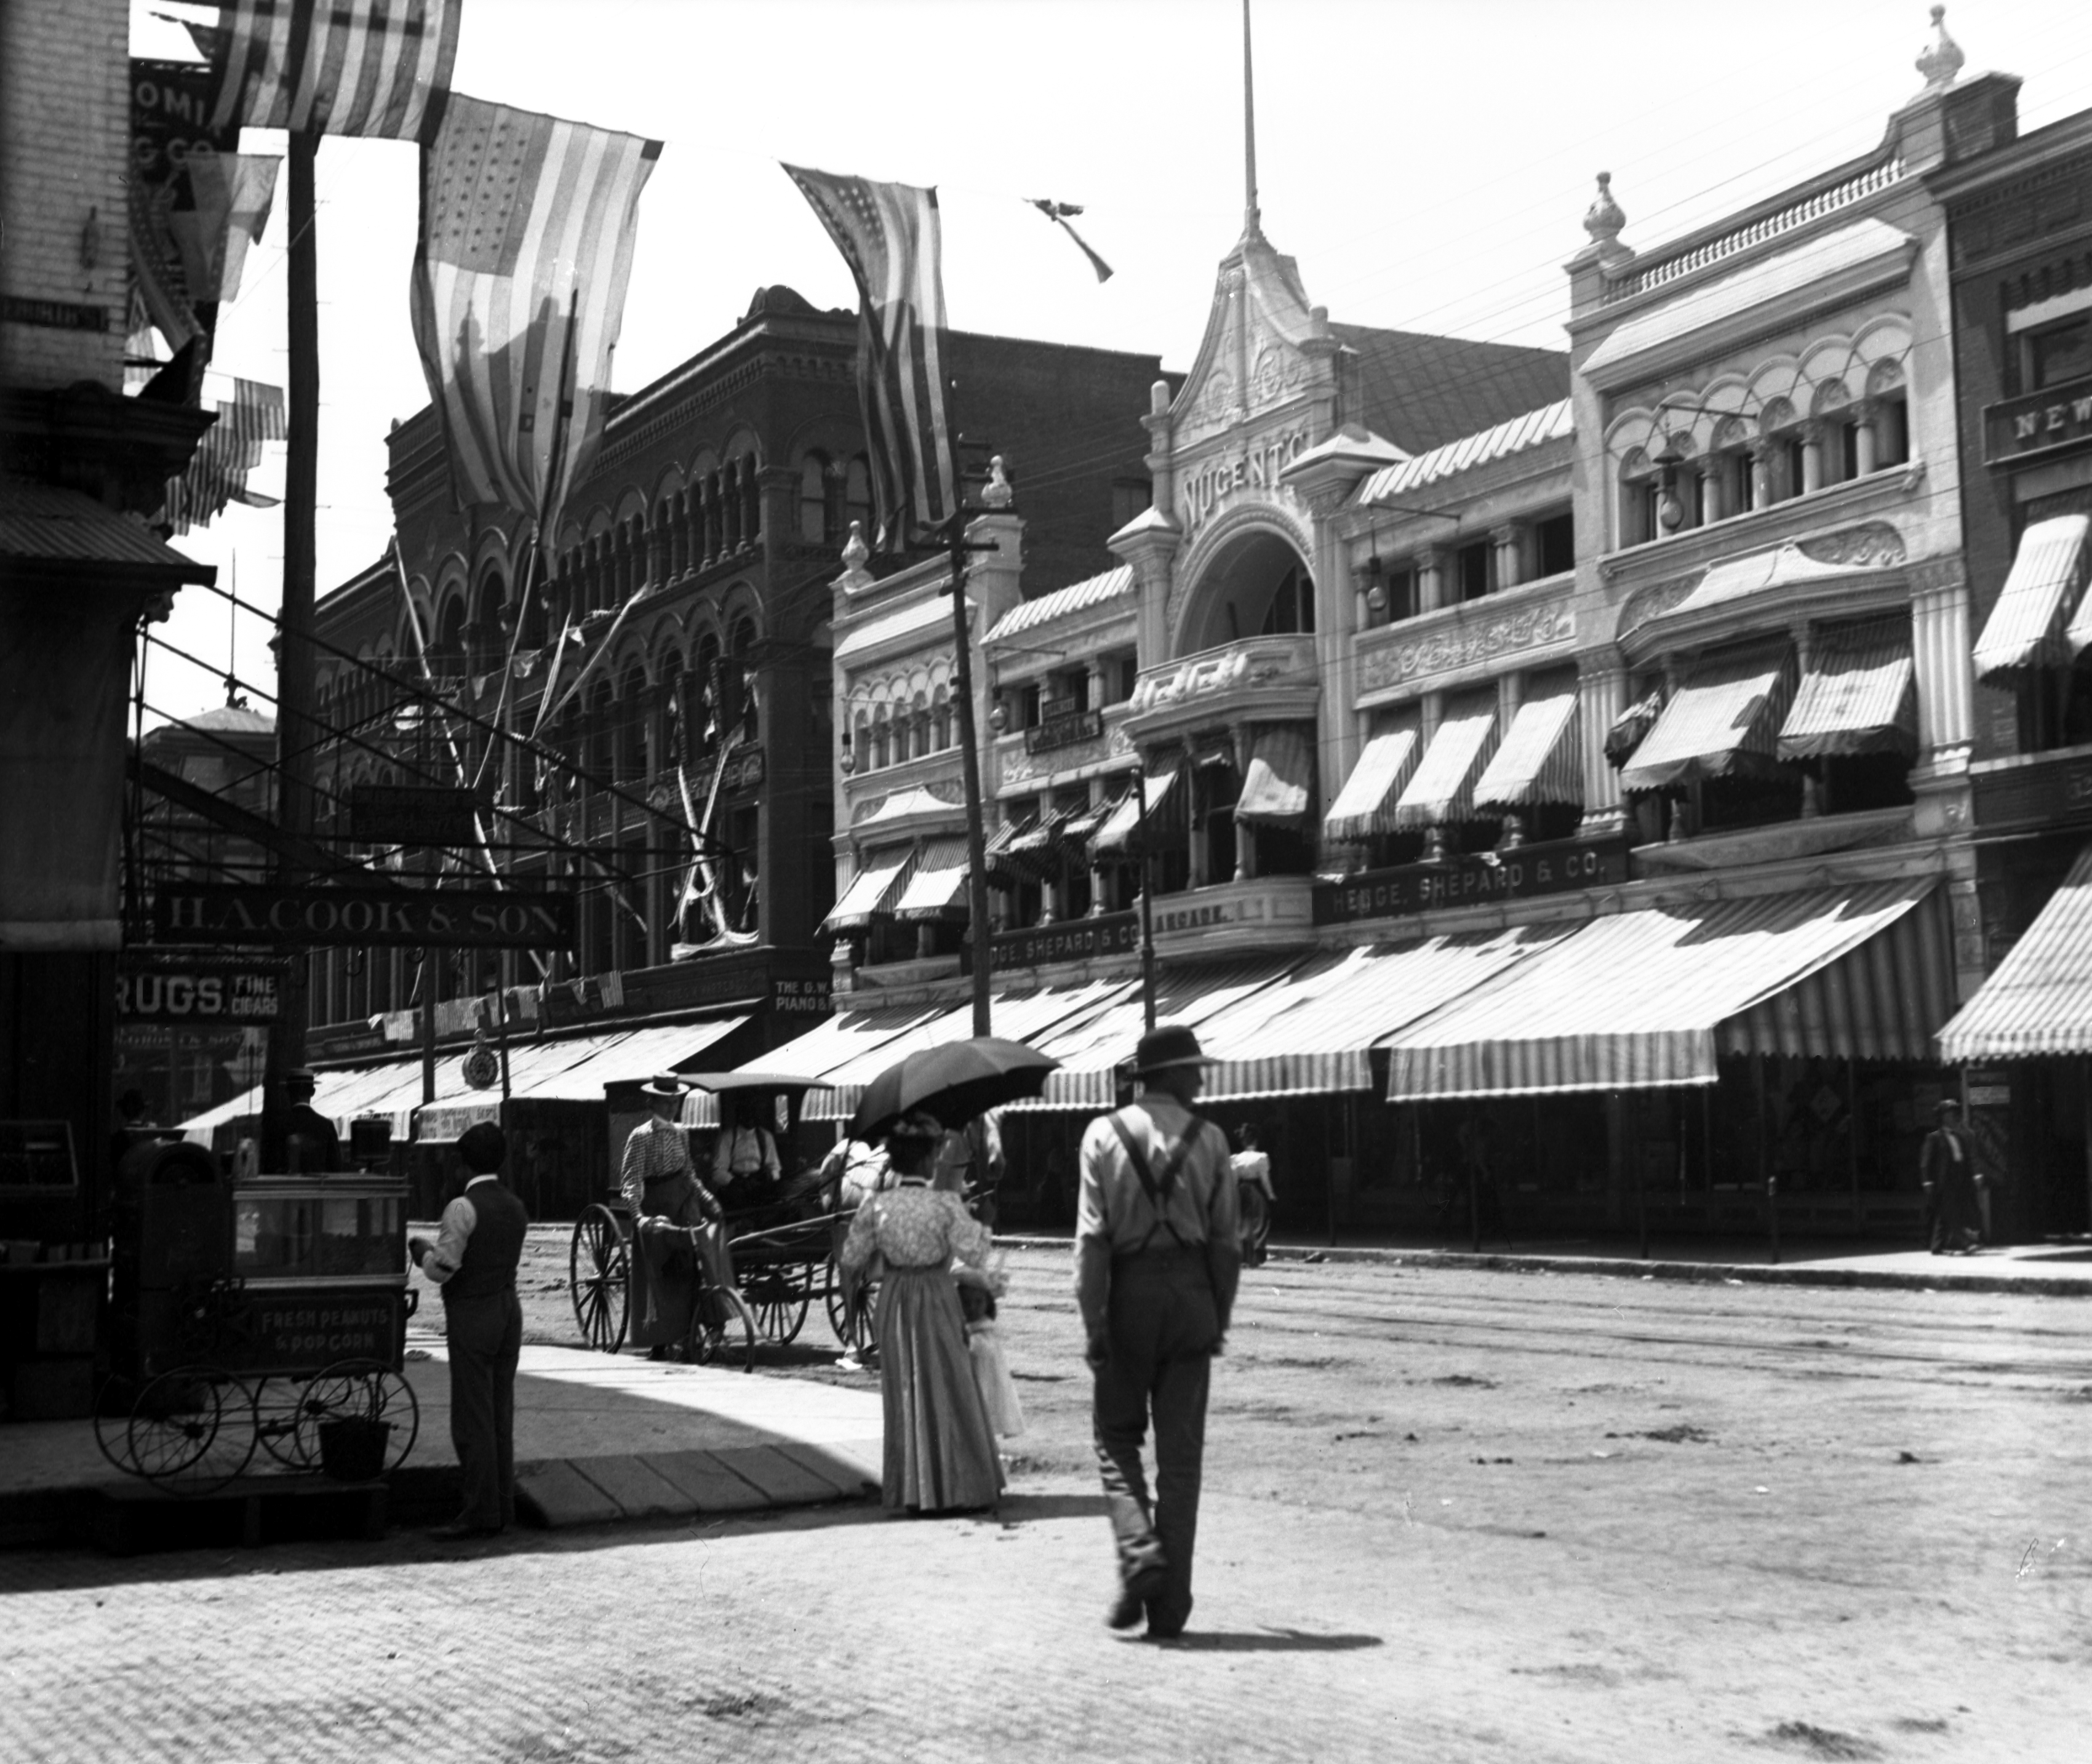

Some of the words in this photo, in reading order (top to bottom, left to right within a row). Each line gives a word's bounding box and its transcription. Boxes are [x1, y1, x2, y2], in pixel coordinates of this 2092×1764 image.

[1419, 864, 1523, 900] SHEPARD
[1536, 860, 1552, 884] &
[429, 903, 460, 935] &
[471, 905, 567, 935] SON.
[1026, 931, 1093, 959] SHEPARD
[1101, 928, 1111, 947] &
[235, 976, 275, 994] FINE
[775, 981, 799, 994] THE
[231, 997, 278, 1015] CIGARS
[262, 1311, 316, 1334] FRESH
[321, 1308, 388, 1329] PEANUTS
[275, 1334, 287, 1351] &
